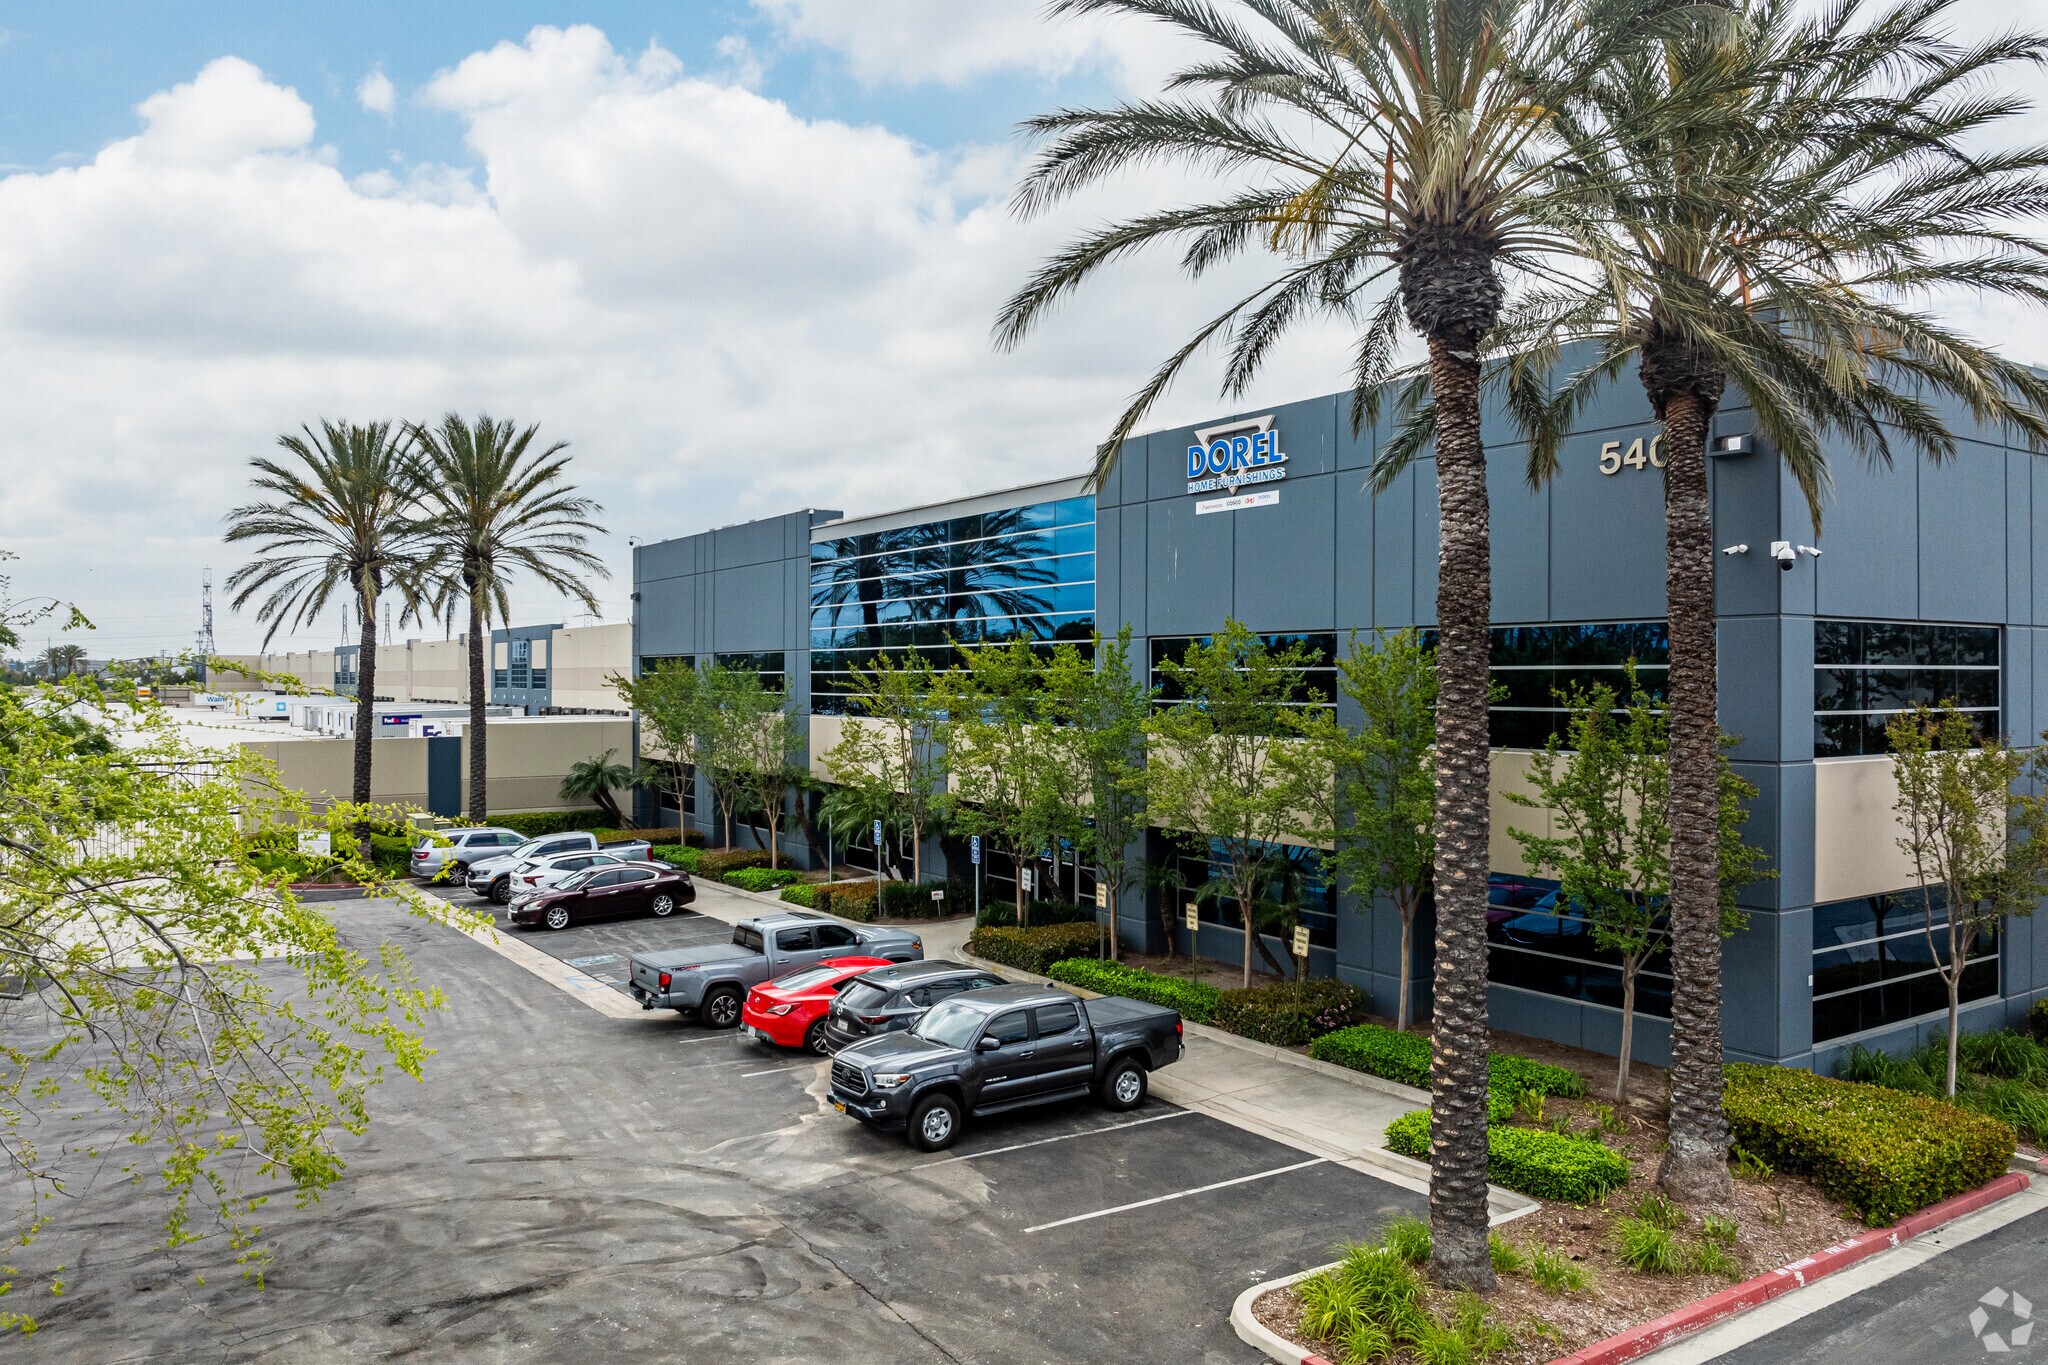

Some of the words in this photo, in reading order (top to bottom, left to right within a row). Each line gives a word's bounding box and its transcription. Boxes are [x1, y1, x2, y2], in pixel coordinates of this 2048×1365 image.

[1187, 429, 1284, 478] DOREL
[1187, 479, 1216, 494] HOME
[1217, 467, 1286, 489] FURNISHINGS
